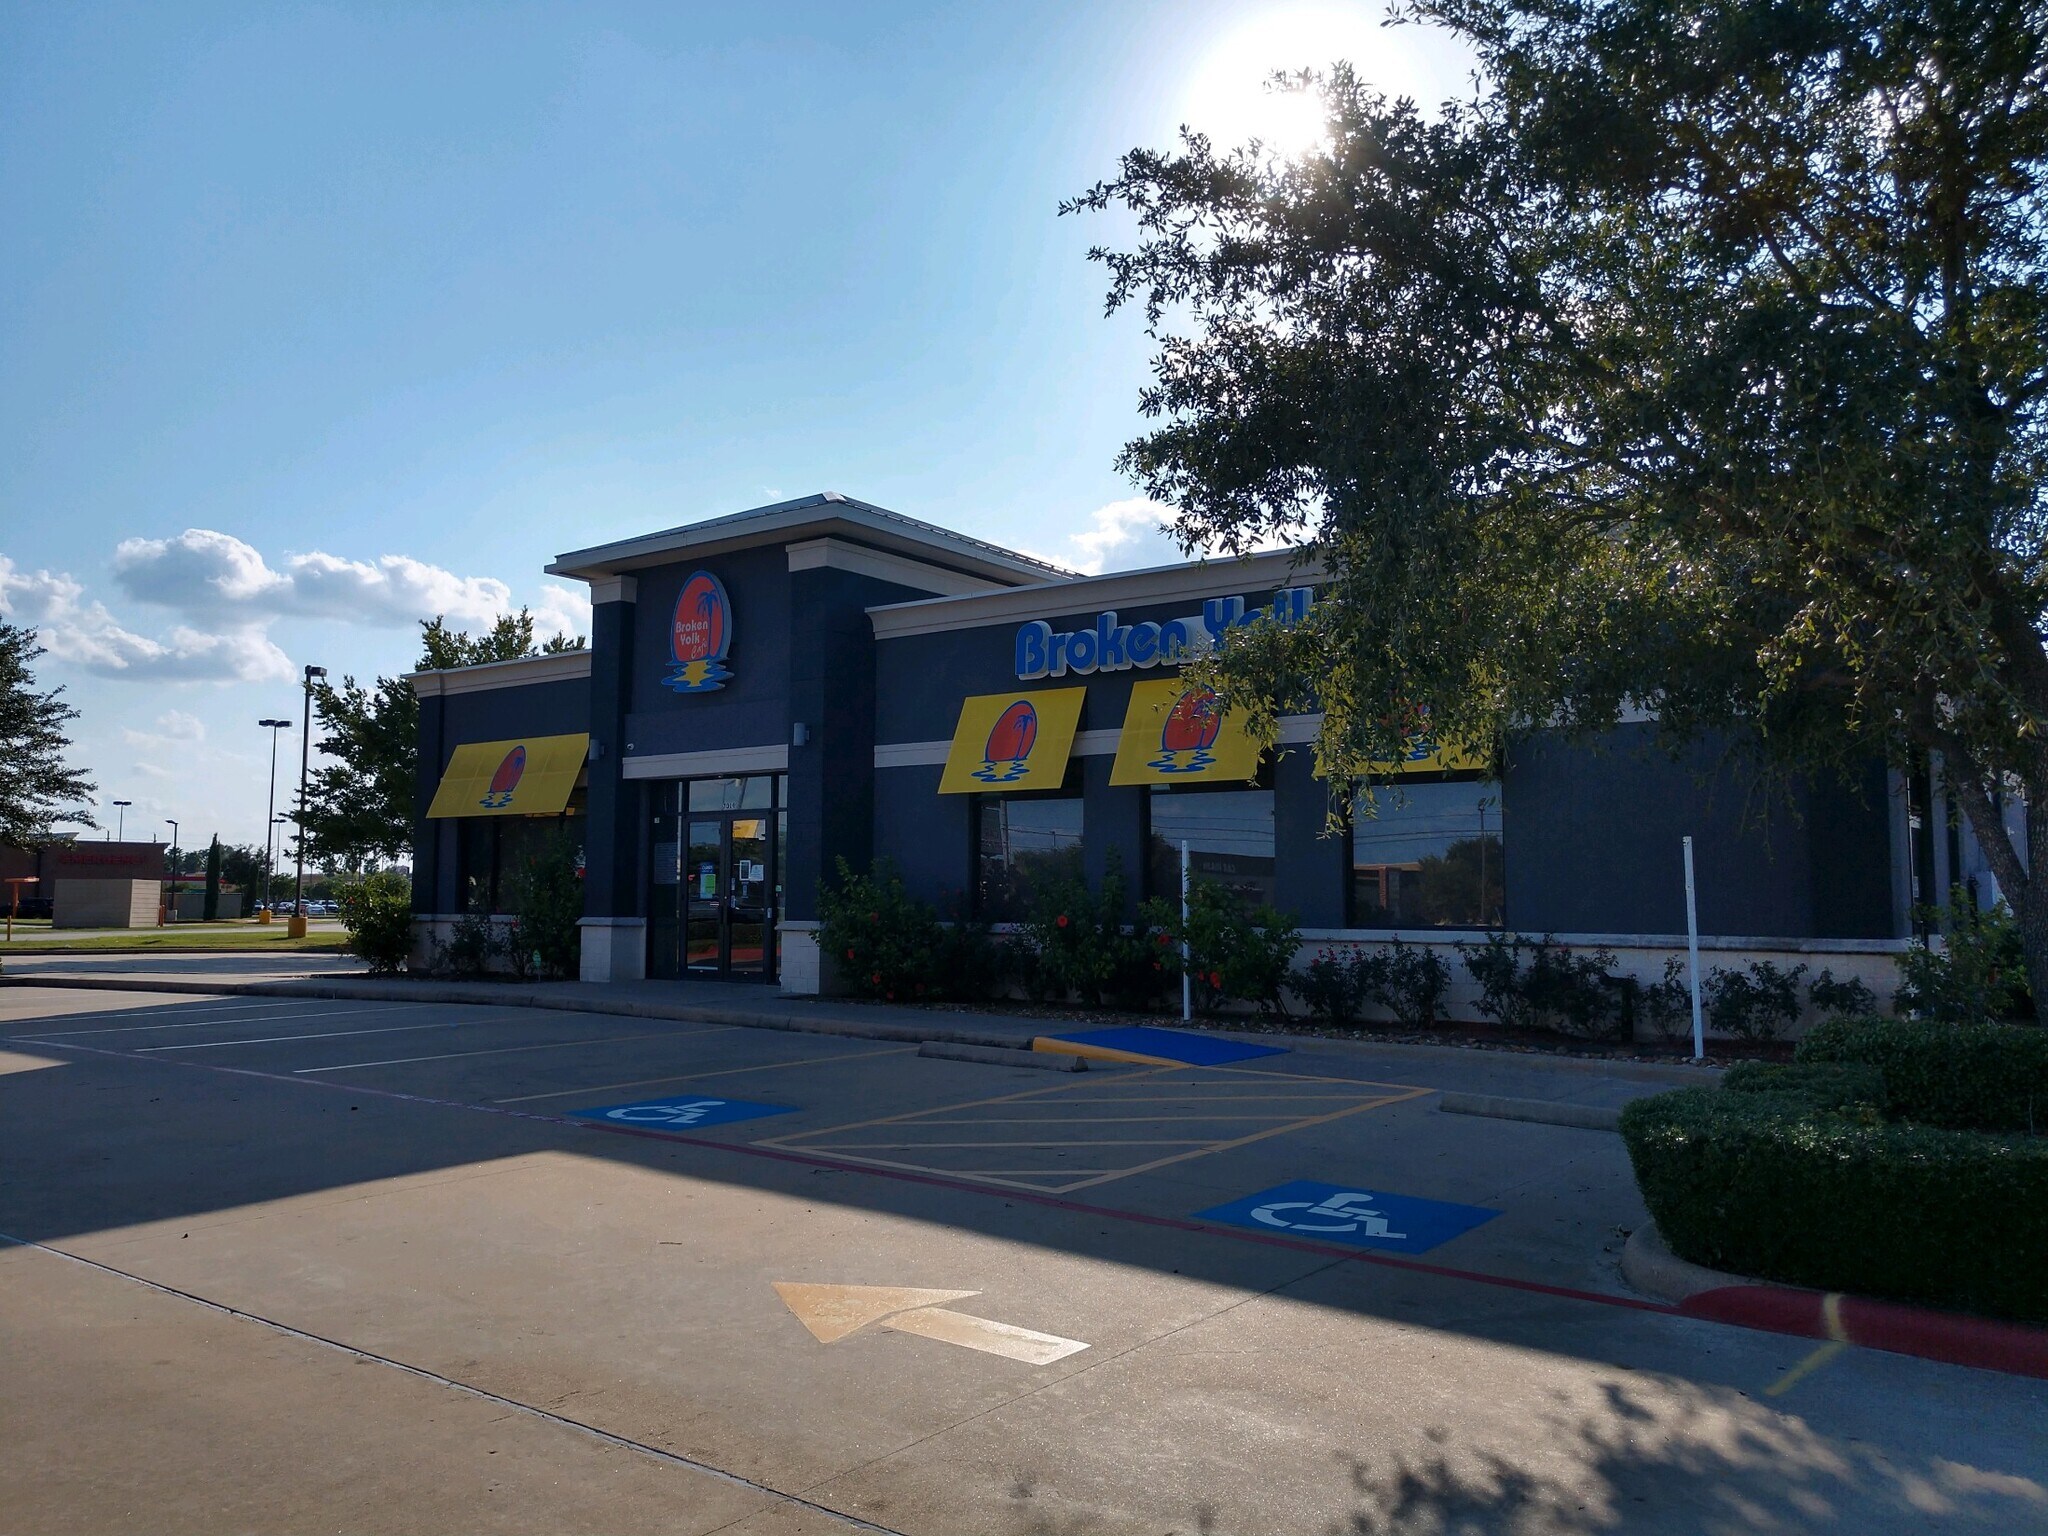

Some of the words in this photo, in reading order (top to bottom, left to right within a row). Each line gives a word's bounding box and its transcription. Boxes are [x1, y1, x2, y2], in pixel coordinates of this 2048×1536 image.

[676, 620, 708, 633] Broken
[680, 632, 700, 646] Yolk
[1015, 611, 1191, 680] Broken
